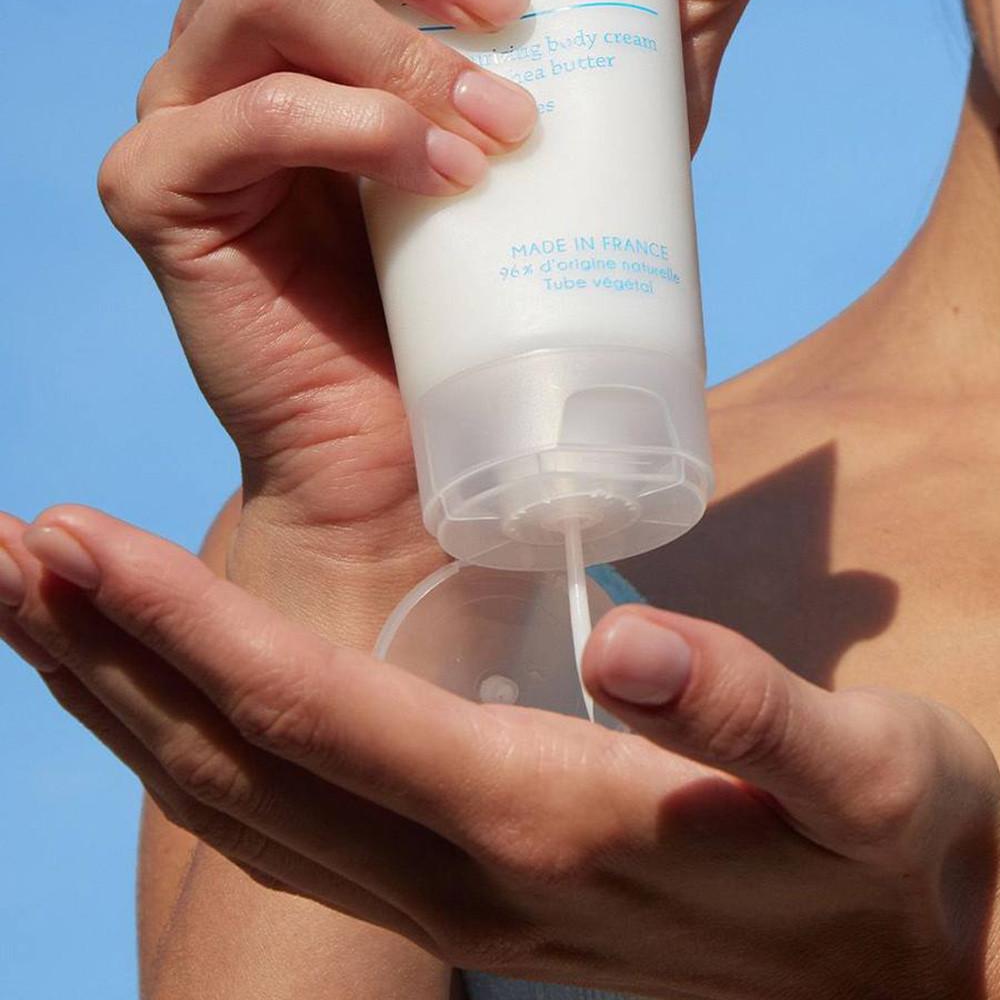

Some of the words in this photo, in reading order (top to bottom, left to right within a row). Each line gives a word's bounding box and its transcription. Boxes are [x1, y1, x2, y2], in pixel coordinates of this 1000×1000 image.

[603, 31, 657, 52] cream
[550, 54, 615, 76] butter
[512, 237, 566, 258] MADE
[575, 236, 595, 250] IN
[602, 236, 668, 260] FRANCE
[540, 257, 617, 275] d'origine
[622, 259, 680, 284] naturelle
[544, 278, 587, 291] Tube
